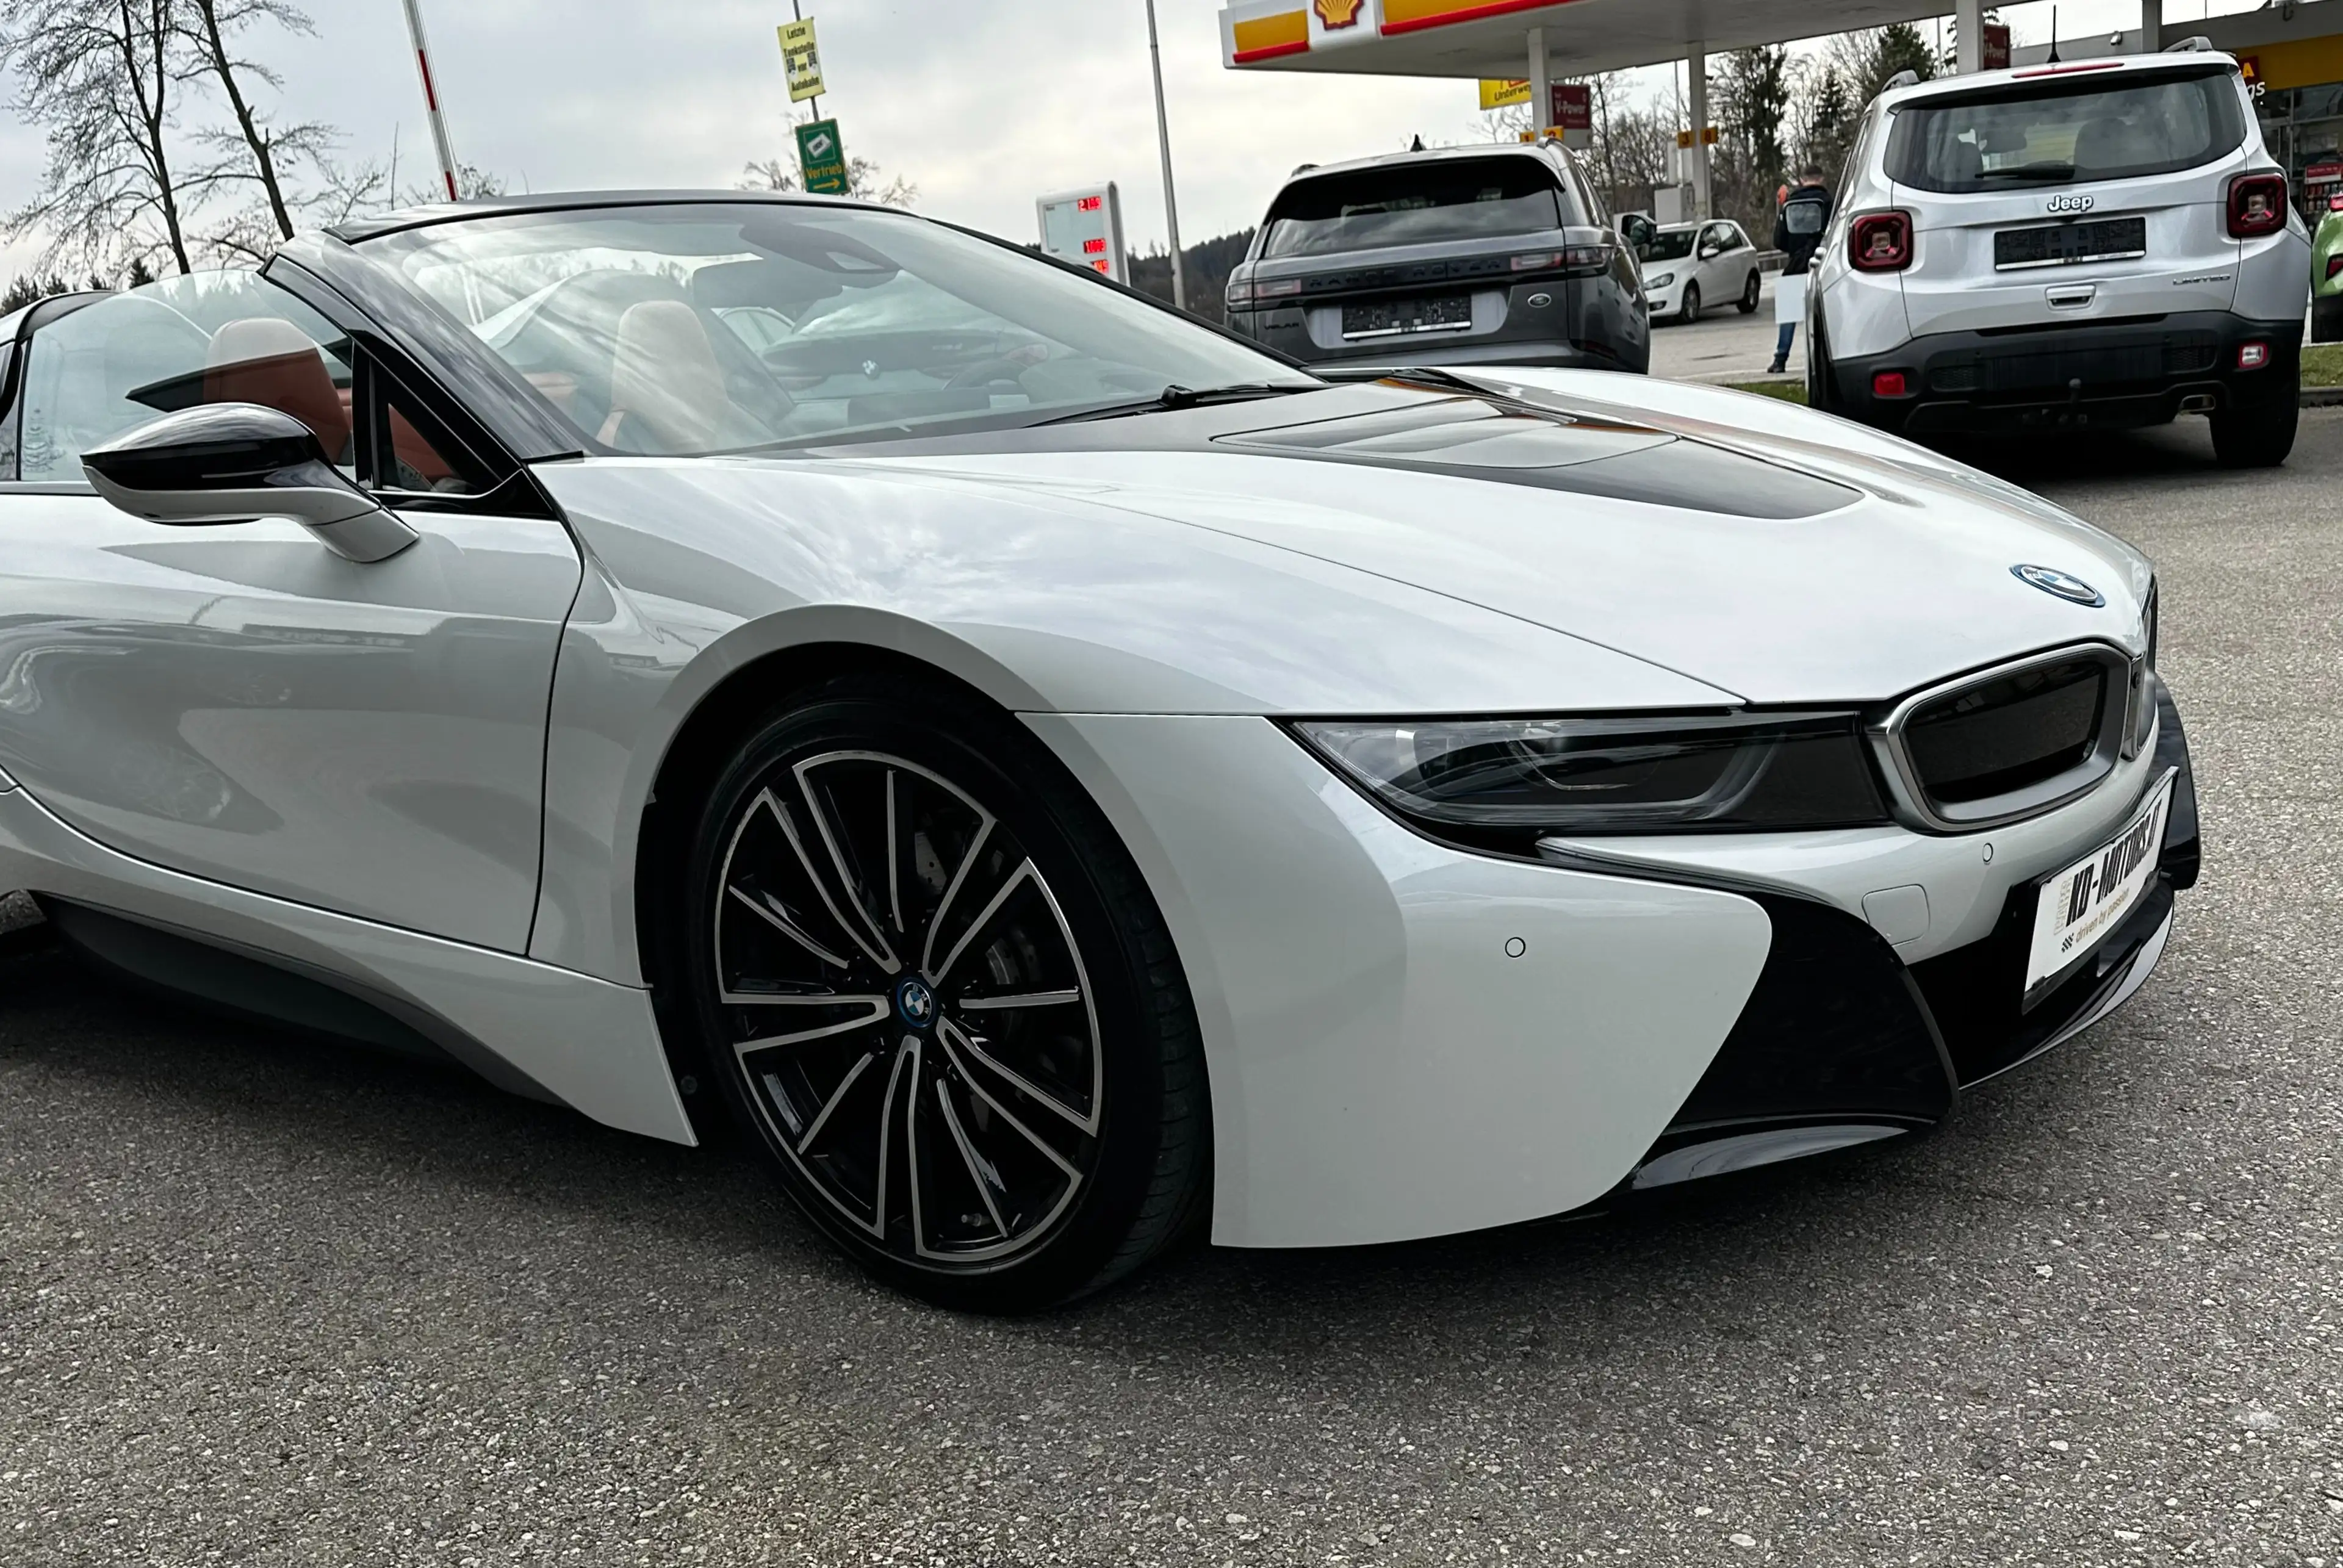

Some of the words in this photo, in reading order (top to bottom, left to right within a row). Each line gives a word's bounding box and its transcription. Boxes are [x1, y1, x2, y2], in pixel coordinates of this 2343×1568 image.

[786, 26, 806, 40] Letzte
[783, 41, 815, 57] Tankstelle
[791, 76, 820, 92] Autobahn
[1555, 100, 1586, 115] V-Power
[806, 162, 842, 179] Vertrieb
[2047, 195, 2094, 212] Jeep
